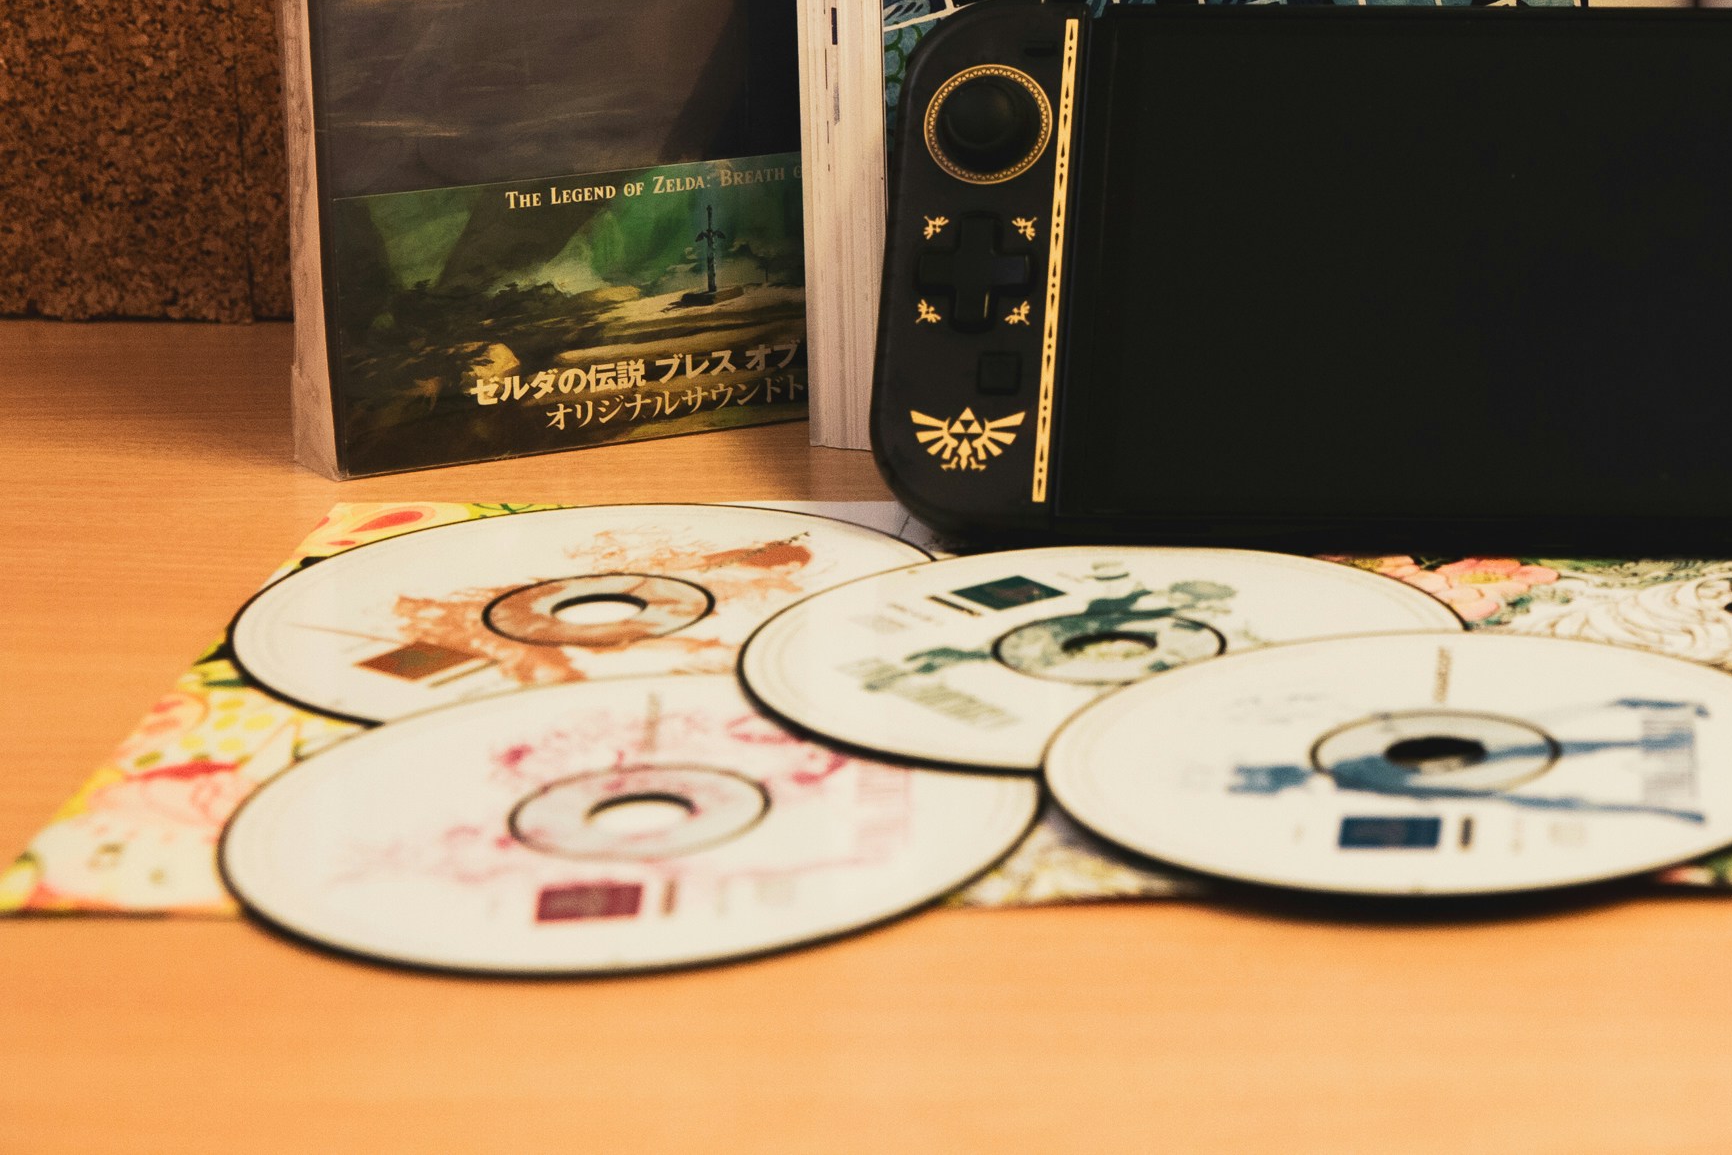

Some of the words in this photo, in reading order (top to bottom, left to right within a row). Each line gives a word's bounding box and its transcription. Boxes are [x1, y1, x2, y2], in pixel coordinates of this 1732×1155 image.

[505, 191, 542, 209] THE
[550, 185, 616, 205] LEGEND
[623, 182, 645, 197] OF
[652, 175, 711, 194] ZELDA:
[720, 167, 785, 187] BREATH
[470, 357, 647, 406] ゼルダの伝説
[655, 349, 737, 383] ブレス
[745, 339, 800, 371] オブ
[545, 374, 804, 431] オリジナルサウンドト
